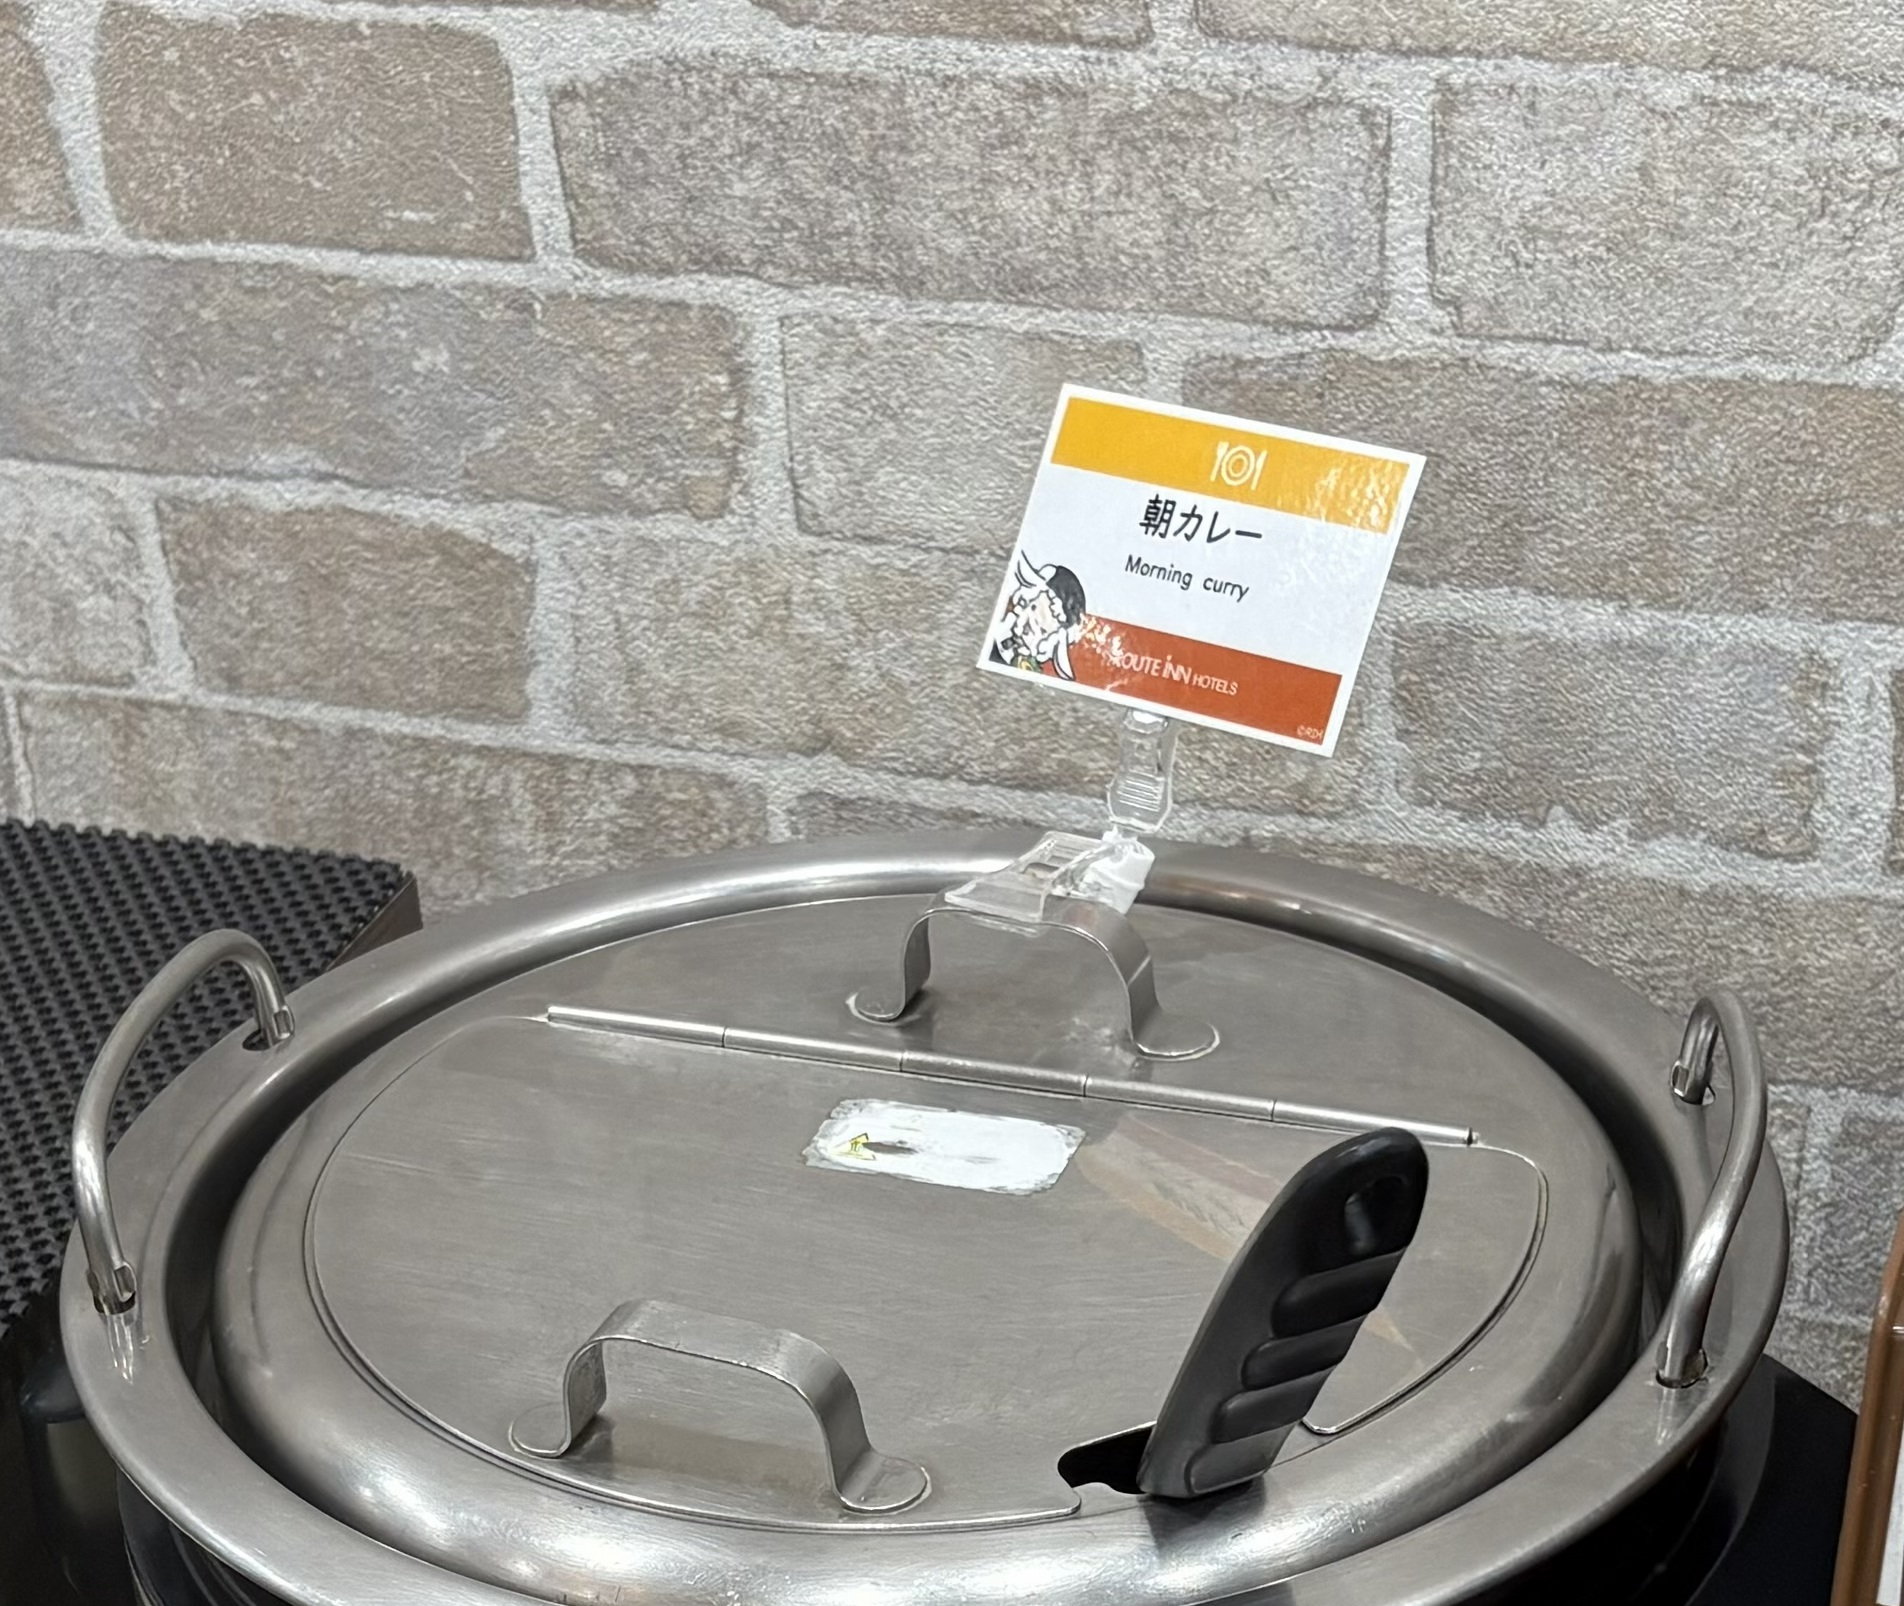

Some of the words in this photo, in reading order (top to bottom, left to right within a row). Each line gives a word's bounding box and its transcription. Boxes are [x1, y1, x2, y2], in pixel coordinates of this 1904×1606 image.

[1139, 494, 1263, 543] 朝カレー
[1125, 554, 1193, 590] Morning
[1203, 576, 1249, 602] curry
[1193, 674, 1238, 696] HOTELS
